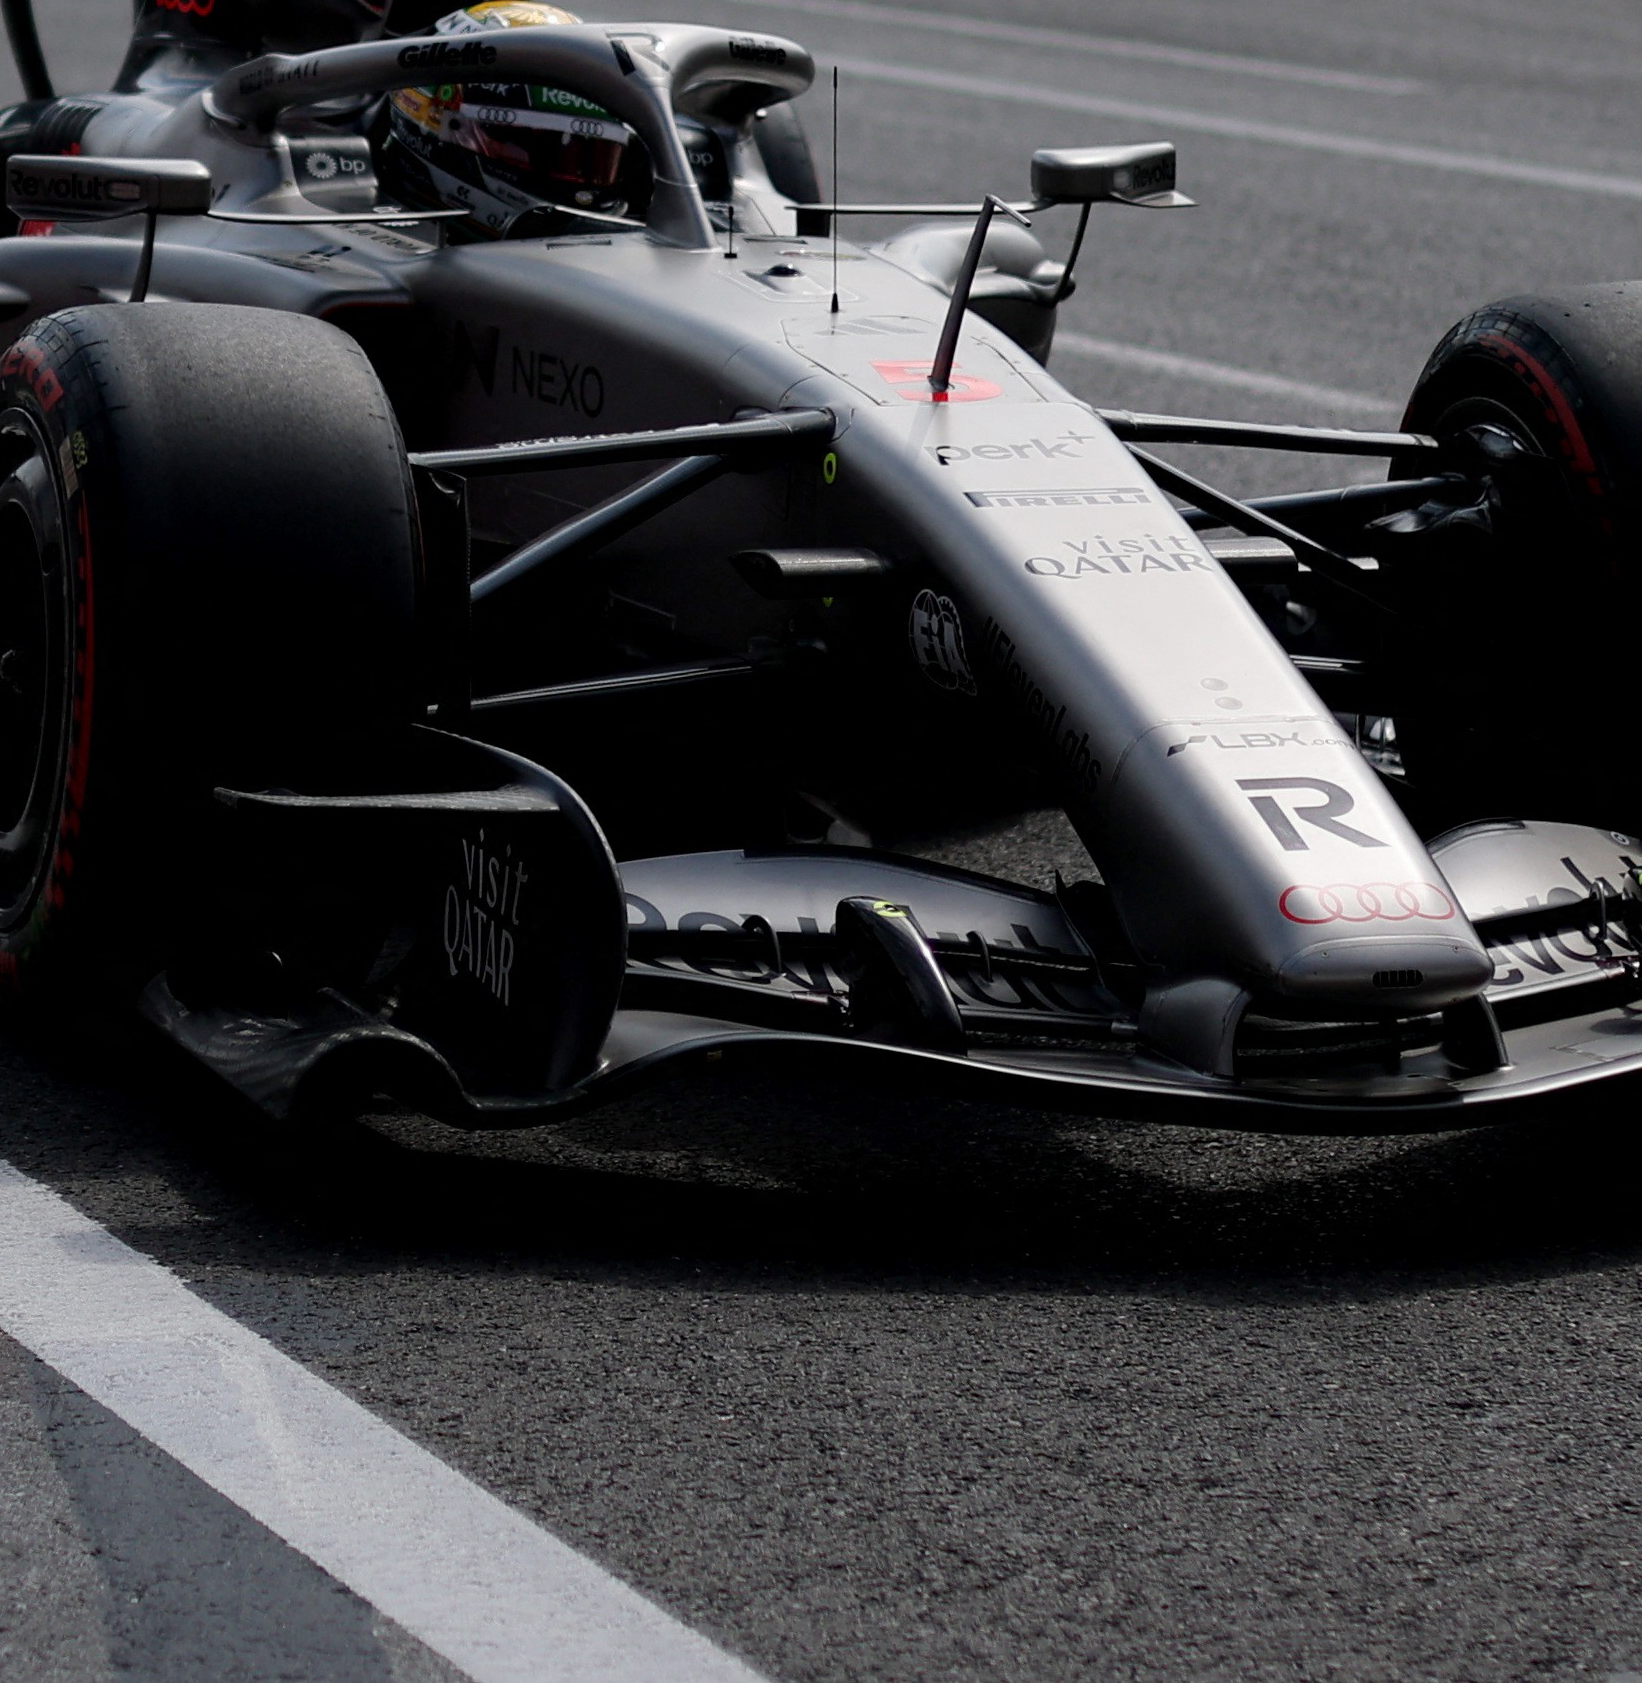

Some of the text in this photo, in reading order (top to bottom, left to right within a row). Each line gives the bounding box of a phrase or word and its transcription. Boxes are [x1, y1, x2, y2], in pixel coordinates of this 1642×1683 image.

[398, 41, 497, 68] Gillette
[340, 156, 366, 175] bp
[11, 170, 102, 201] Revolut
[512, 346, 604, 418] NEXO
[869, 359, 1003, 404] 5
[962, 487, 1154, 509] PIRELLI
[1062, 533, 1196, 556] visit
[1024, 553, 1216, 580] QATAR
[1234, 777, 1392, 852] R
[462, 827, 528, 926] visit
[443, 884, 514, 1007] QATAR
